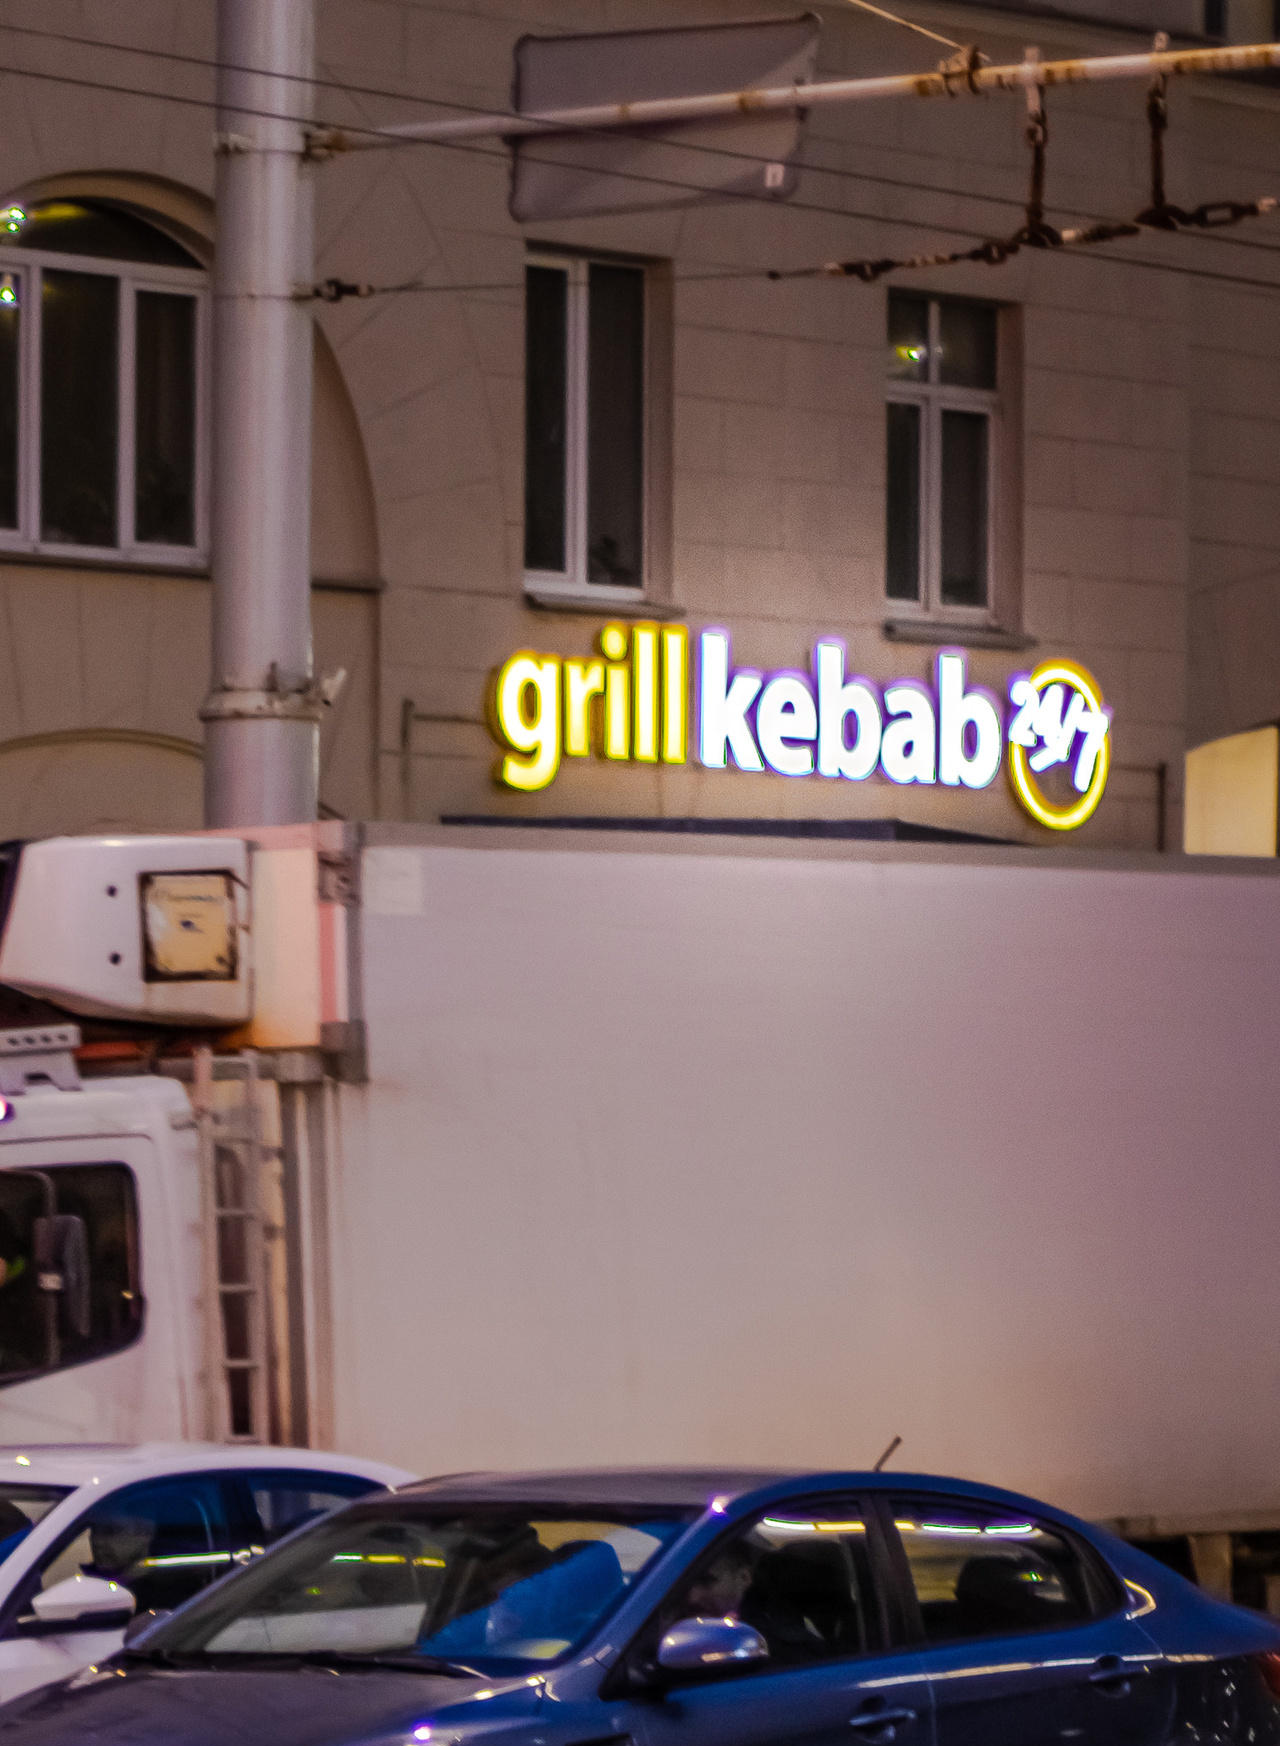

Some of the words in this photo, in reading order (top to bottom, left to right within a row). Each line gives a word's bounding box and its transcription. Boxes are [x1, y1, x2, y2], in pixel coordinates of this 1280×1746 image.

[497, 621, 688, 791] grill
[700, 632, 1002, 789] kebab
[1008, 679, 1110, 793] 24/7
